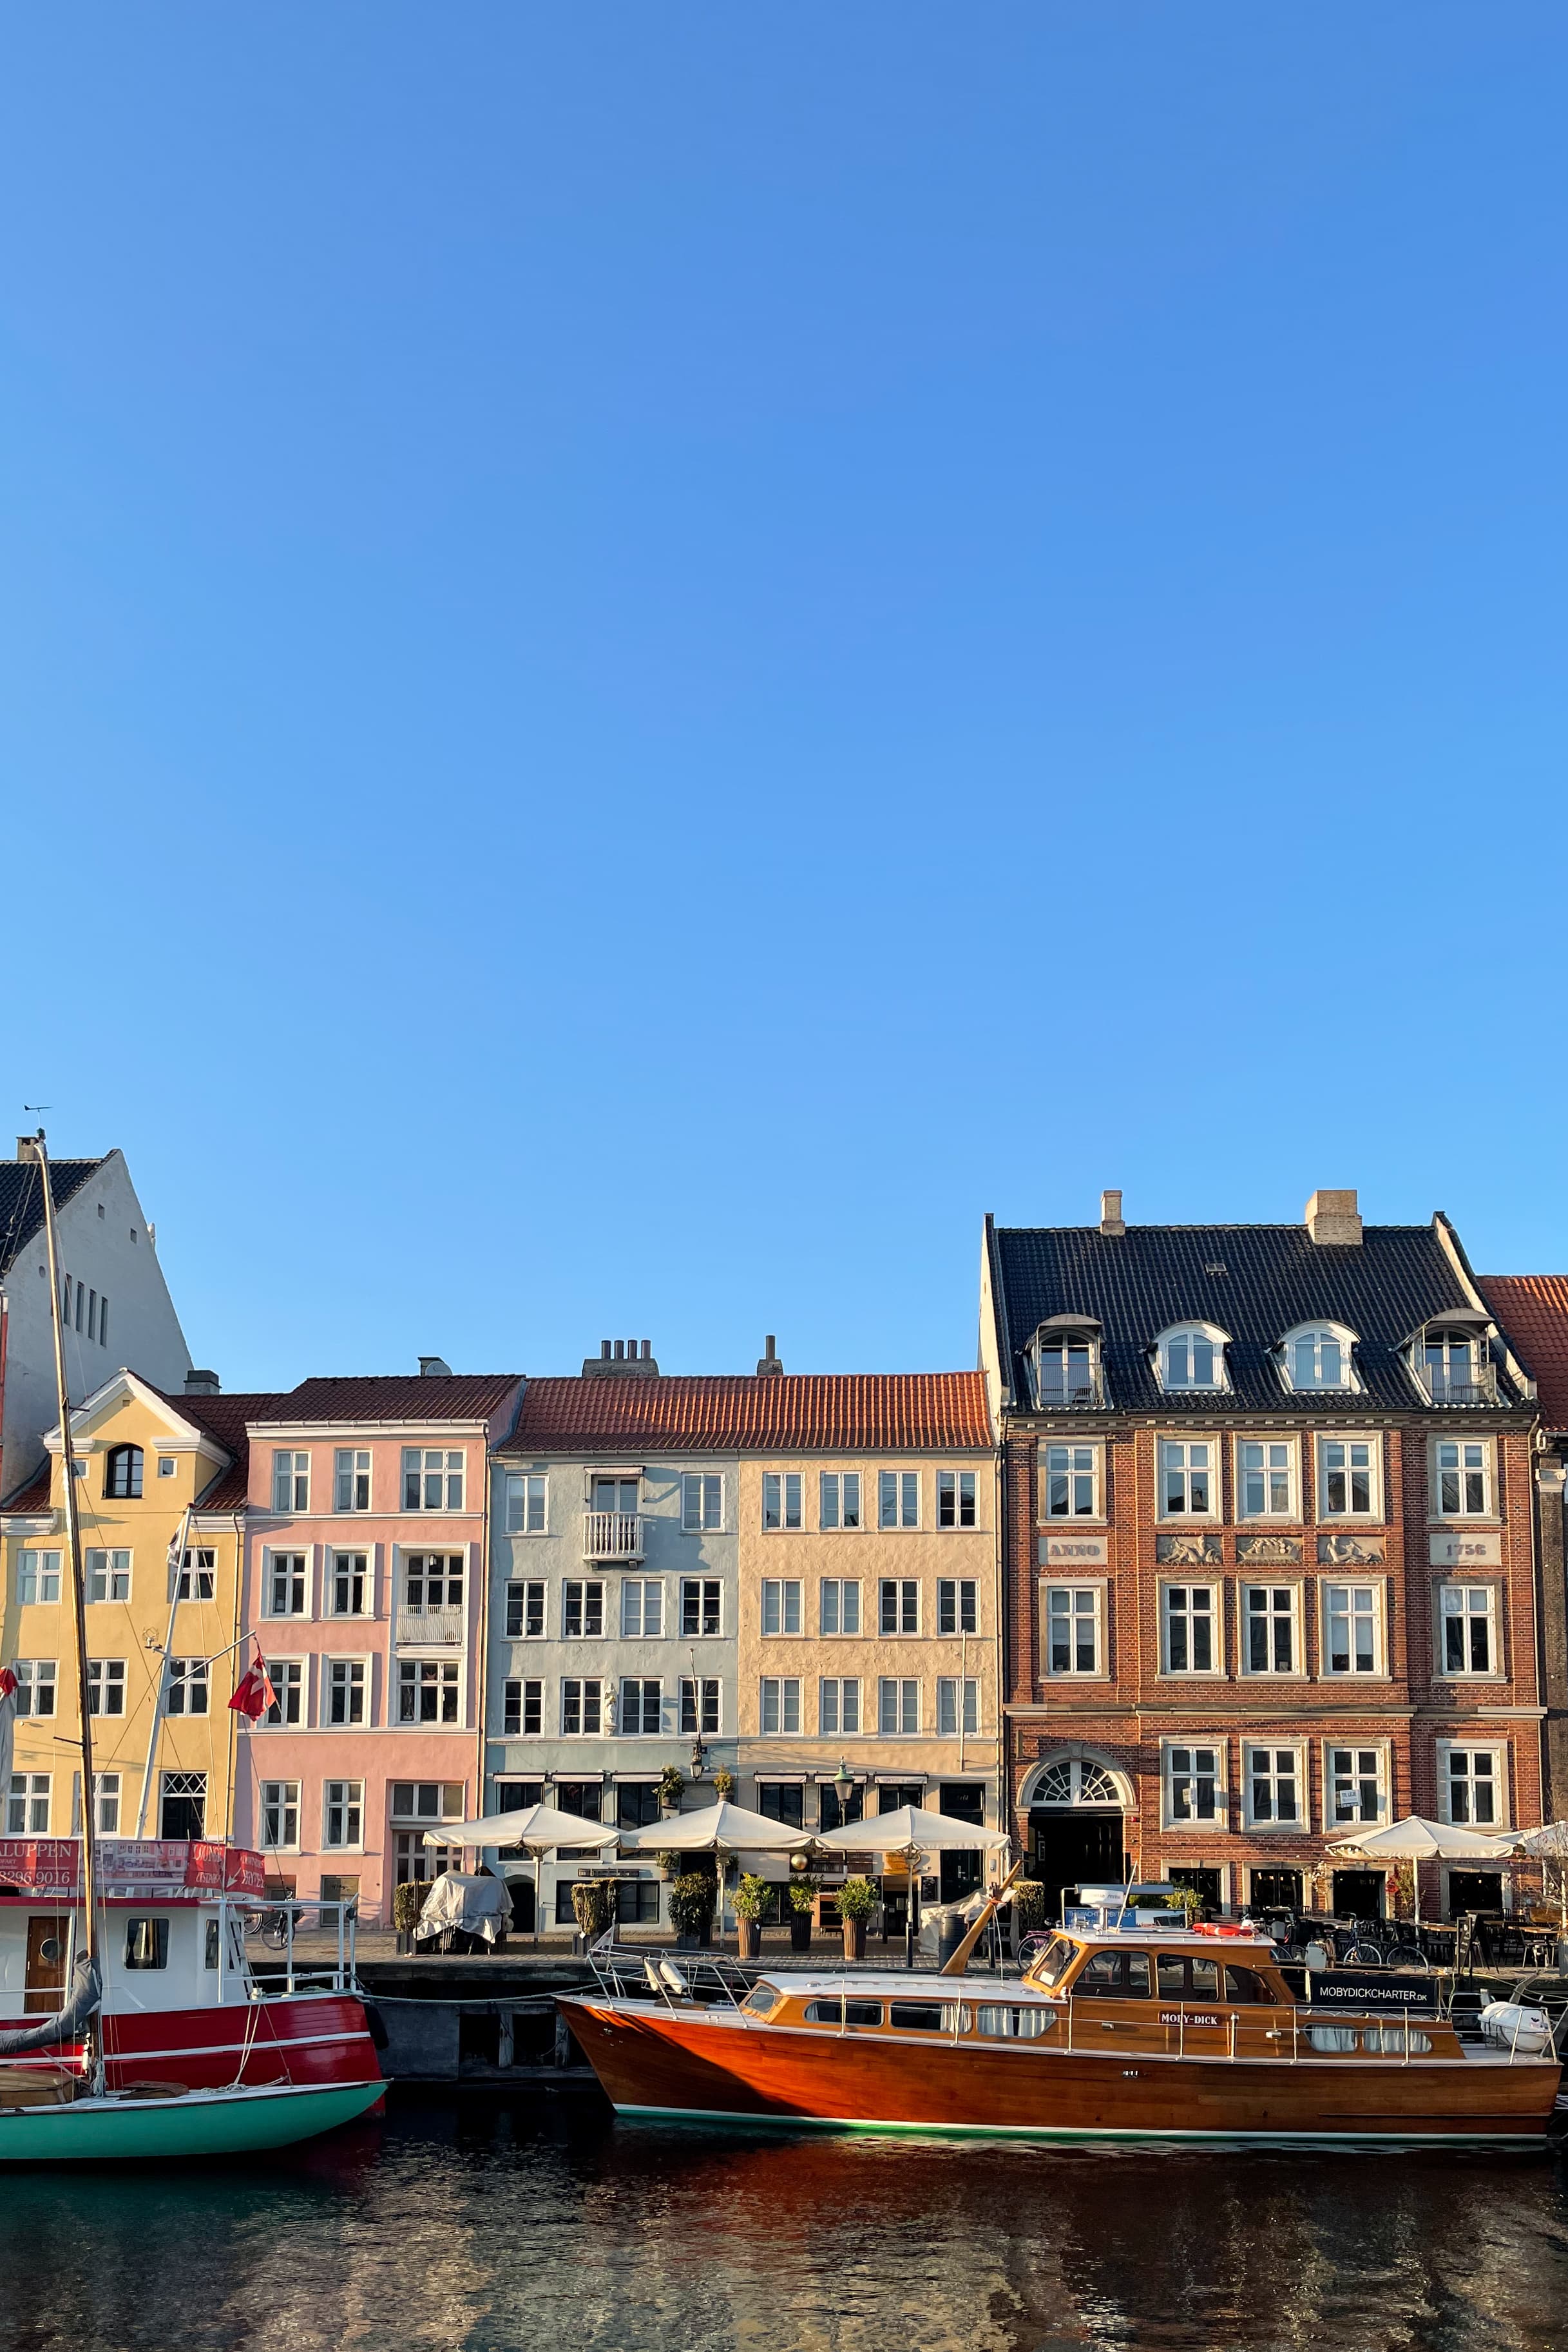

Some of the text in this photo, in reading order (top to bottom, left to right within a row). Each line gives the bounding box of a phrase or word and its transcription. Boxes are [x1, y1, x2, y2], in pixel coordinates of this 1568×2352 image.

[1048, 1544, 1100, 1556] ANNO
[1447, 1544, 1487, 1556] 1756
[0, 1844, 72, 1857] LUPPEN
[36, 1871, 70, 1884] 9016
[241, 1869, 265, 1888] HOTEL
[1320, 1987, 1428, 2001] MOBYDICKCHARTER.DK
